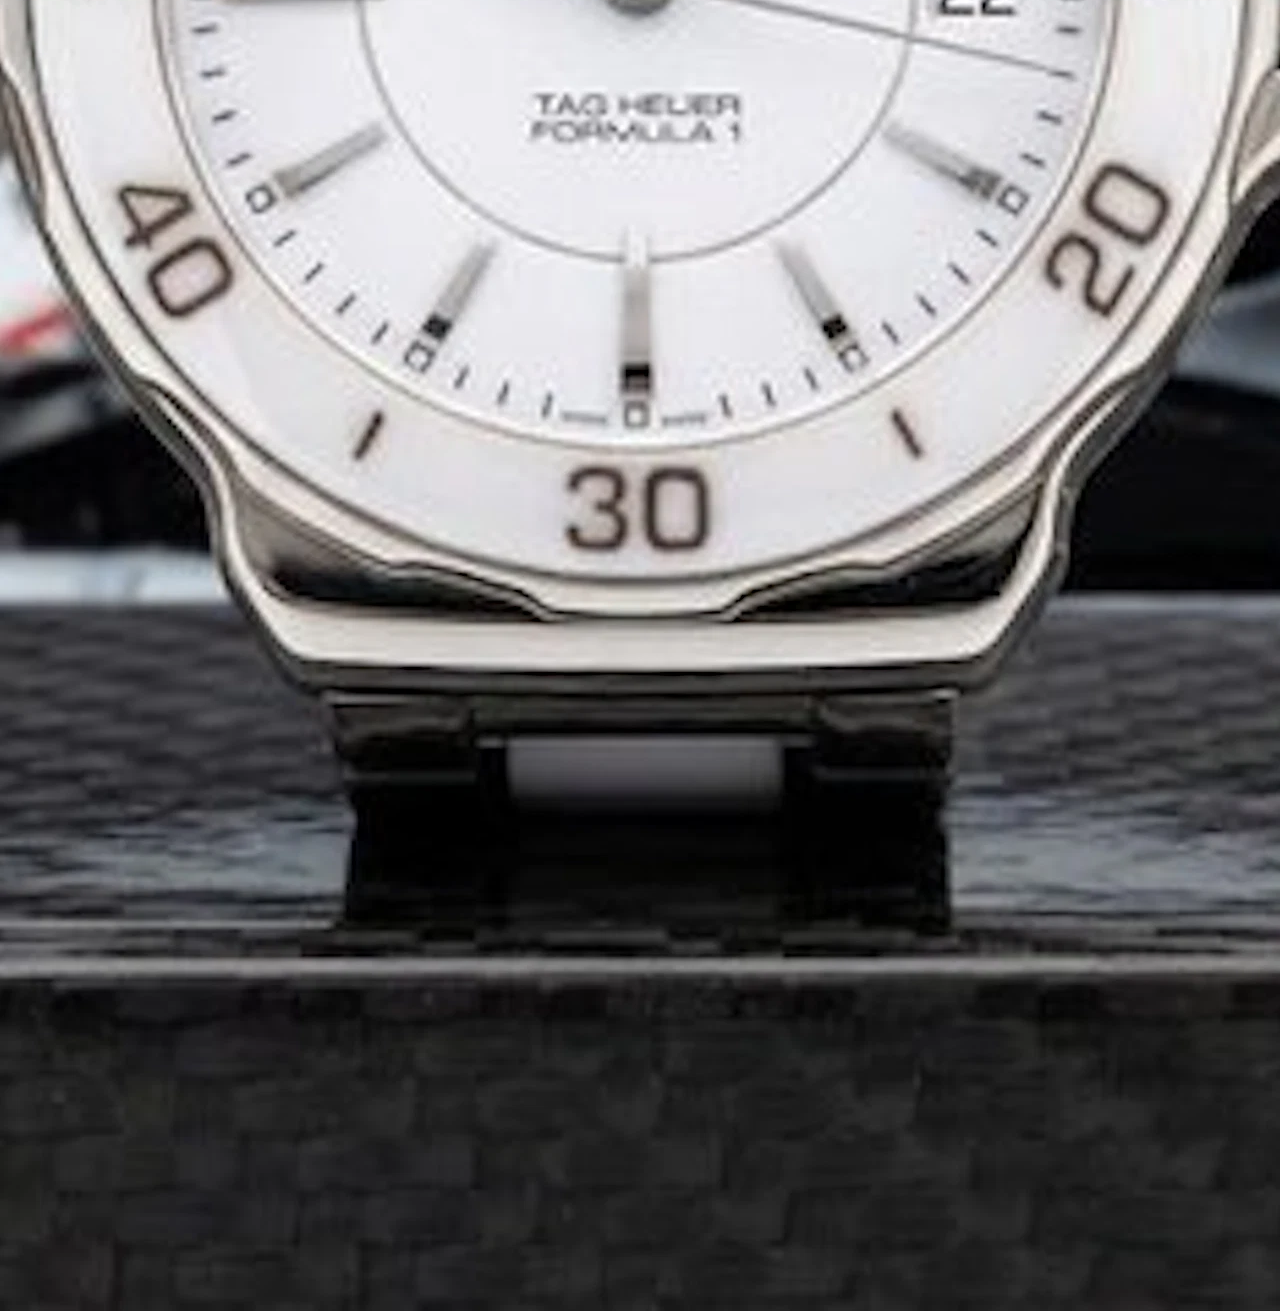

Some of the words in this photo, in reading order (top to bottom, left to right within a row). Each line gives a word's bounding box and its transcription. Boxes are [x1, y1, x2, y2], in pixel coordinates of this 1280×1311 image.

[530, 120, 713, 143] FORMULA
[728, 120, 742, 143] 1
[534, 92, 609, 116] TAG
[618, 92, 741, 116] HEUER
[117, 182, 234, 319] 40
[1043, 159, 1171, 318] 20
[565, 466, 710, 552] 30
